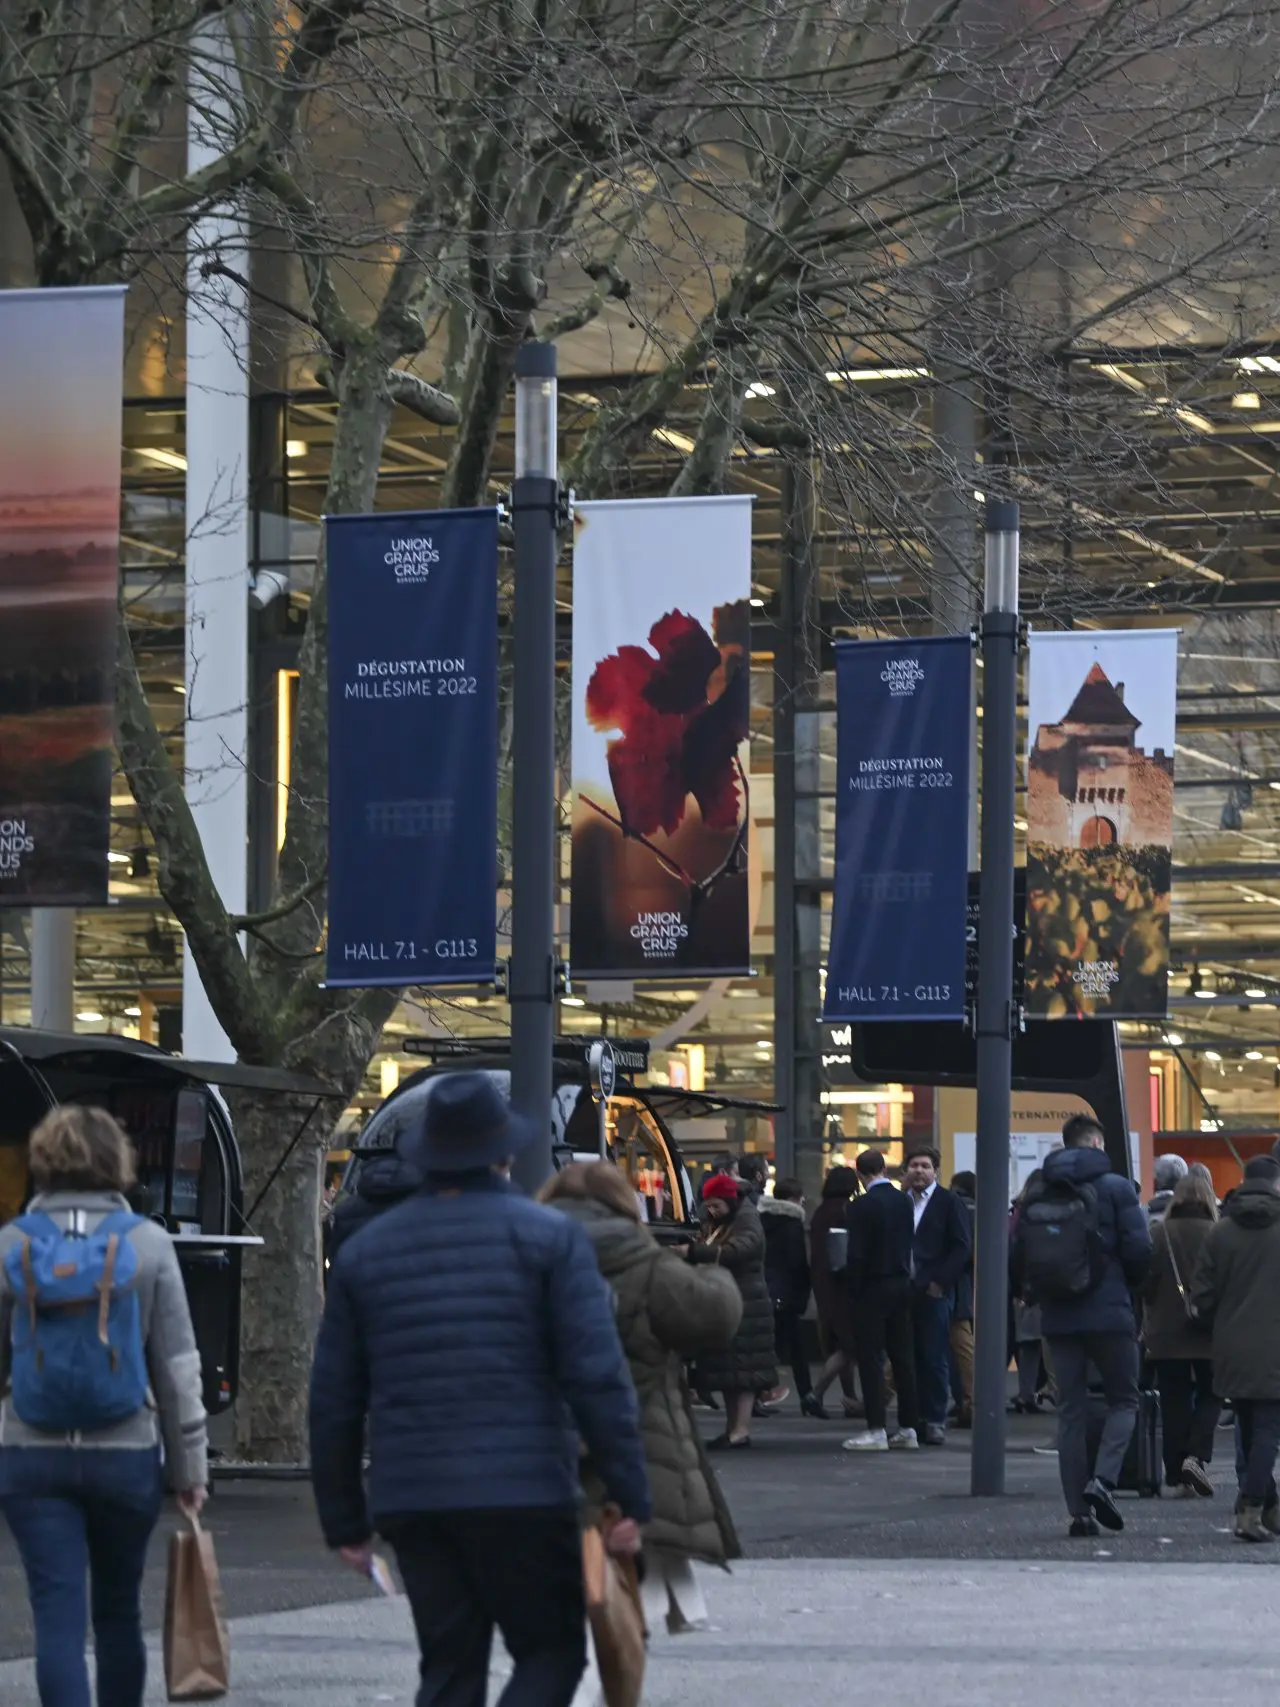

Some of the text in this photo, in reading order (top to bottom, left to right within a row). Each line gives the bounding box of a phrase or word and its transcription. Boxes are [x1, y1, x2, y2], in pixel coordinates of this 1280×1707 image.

[391, 537, 432, 550] UNION
[384, 550, 440, 565] GRANDS
[394, 563, 429, 576] CRUS
[358, 659, 465, 676] DÉGUSTATION
[886, 659, 919, 670] UNION
[880, 669, 925, 682] GRANDS
[345, 677, 477, 699] MILLÉSIME 2022
[888, 680, 916, 691] CRUS
[859, 757, 943, 772] DÉGUSTATION
[849, 772, 953, 790] MILLÉSIME 2022
[0, 836, 34, 852] NDS
[0, 853, 20, 869] US
[637, 912, 681, 925] UNION
[630, 924, 688, 938] GRANDS
[344, 942, 389, 960] HALL
[394, 941, 416, 959] 7.1
[435, 939, 478, 958] G113
[641, 937, 678, 951] CRUS
[1078, 960, 1114, 971] UNION
[1072, 970, 1119, 983] GRANDS
[838, 986, 876, 1001] HALL
[914, 985, 951, 1001] G113
[1081, 982, 1110, 993] CRUS
[1012, 1110, 1089, 1120] TERNATION
